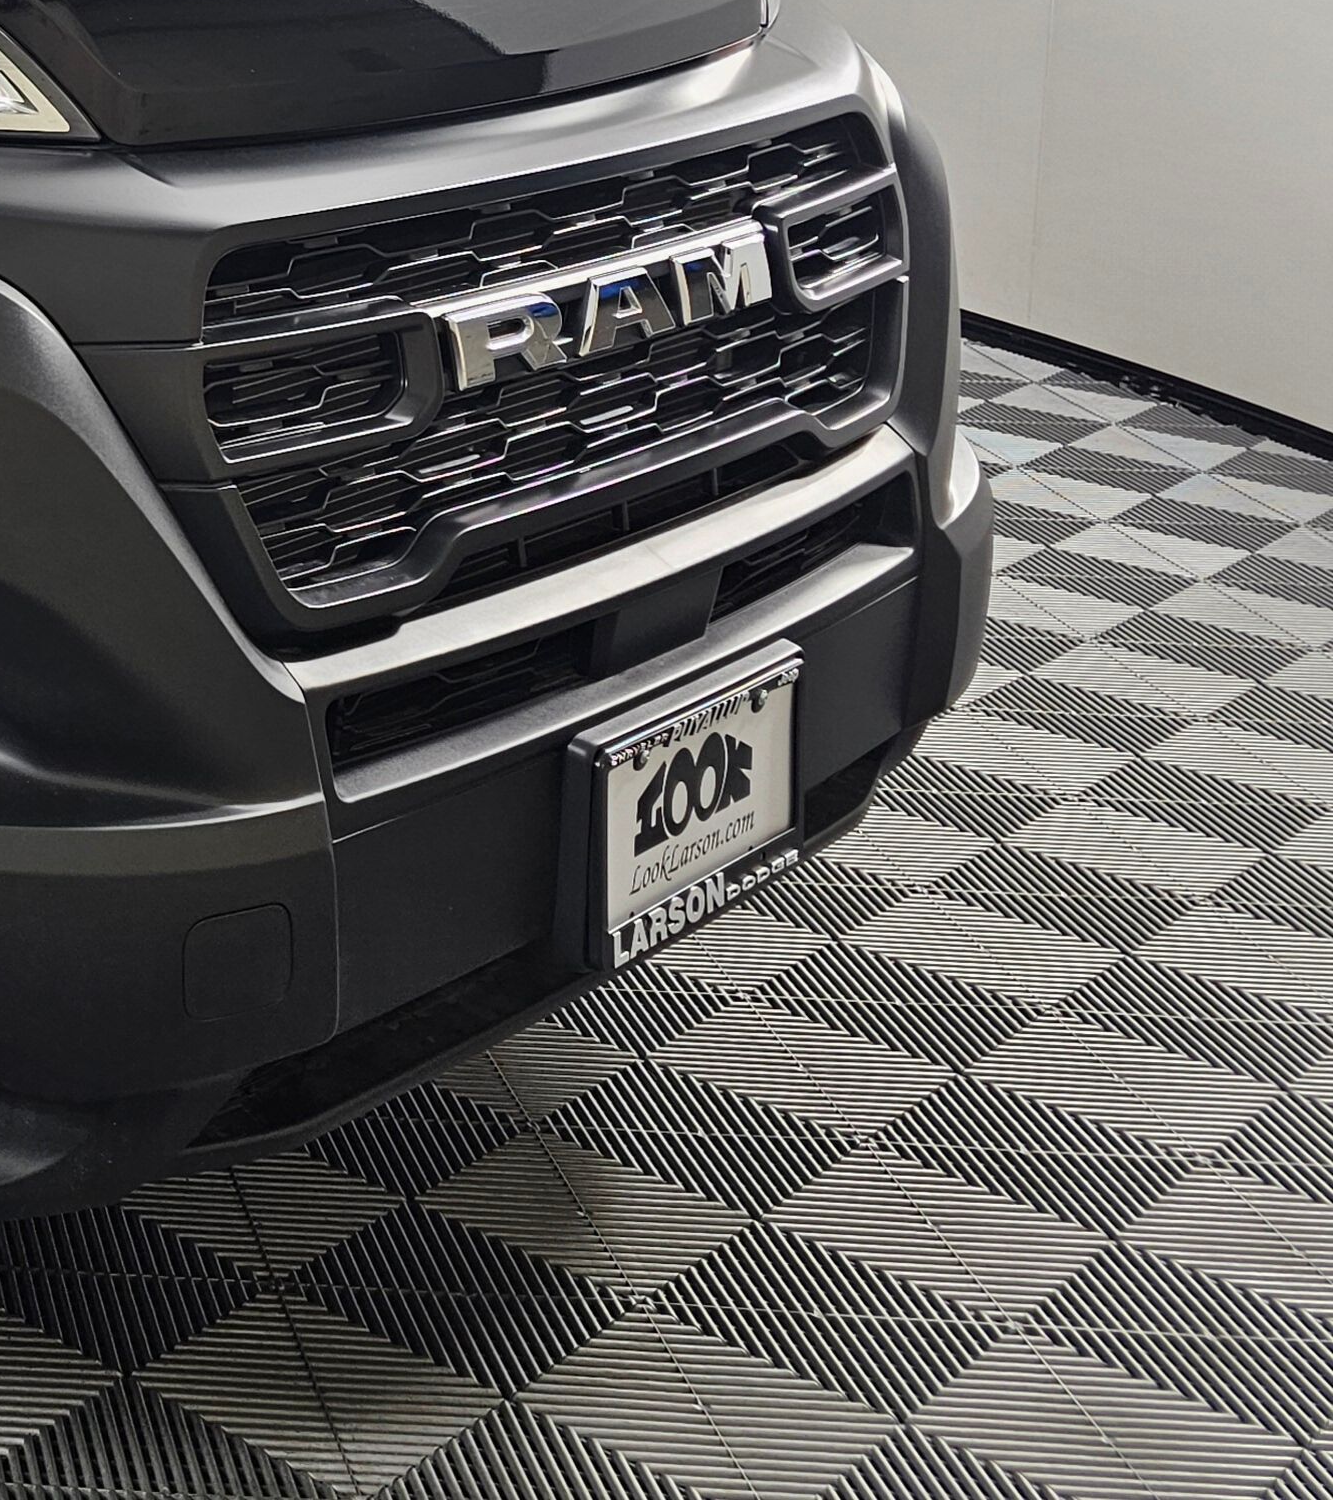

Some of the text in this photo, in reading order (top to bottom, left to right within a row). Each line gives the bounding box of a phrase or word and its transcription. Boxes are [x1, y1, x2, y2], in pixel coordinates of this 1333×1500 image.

[444, 232, 773, 393] RAM
[611, 848, 800, 969] LARSON DODGE
[628, 810, 755, 896] LookLarson.com
